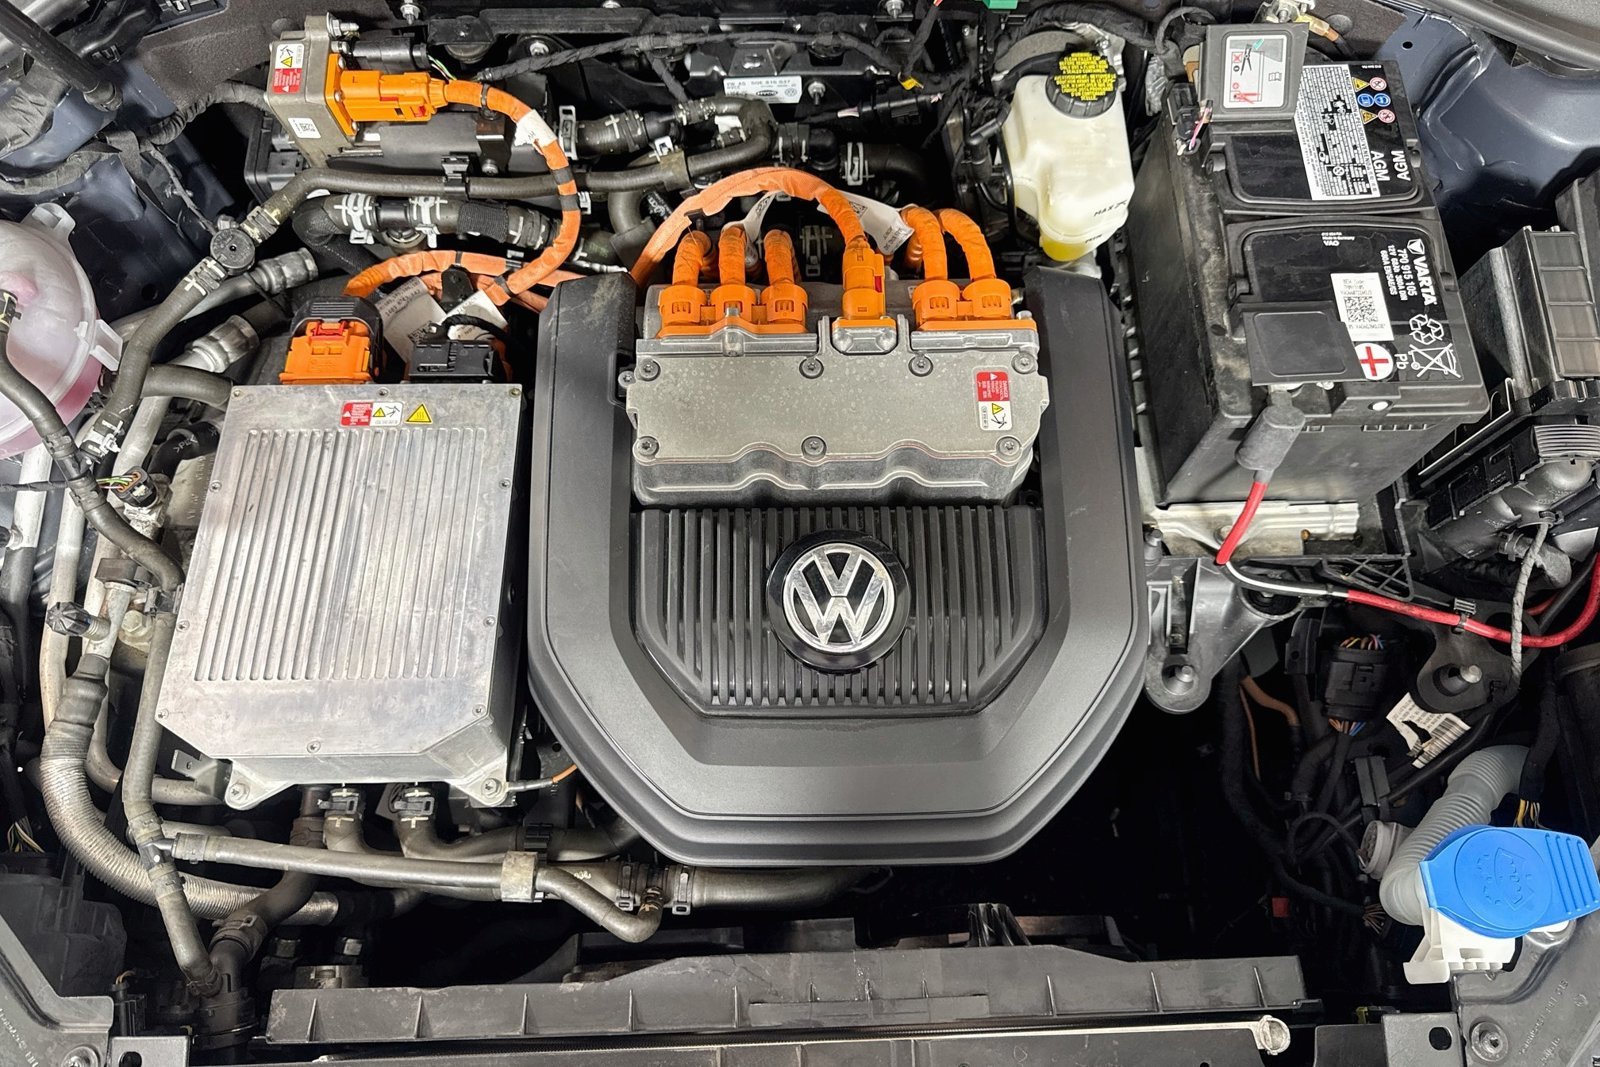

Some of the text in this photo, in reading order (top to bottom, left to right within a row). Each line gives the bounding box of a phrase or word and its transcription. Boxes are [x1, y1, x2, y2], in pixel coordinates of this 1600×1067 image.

[1370, 150, 1390, 181] AGM
[1391, 150, 1411, 182] AGM
[1388, 244, 1397, 256] 12V
[1397, 248, 1418, 296] 7P0 915 105
[1413, 255, 1437, 306] VARTA
[1394, 354, 1407, 370] Pb
